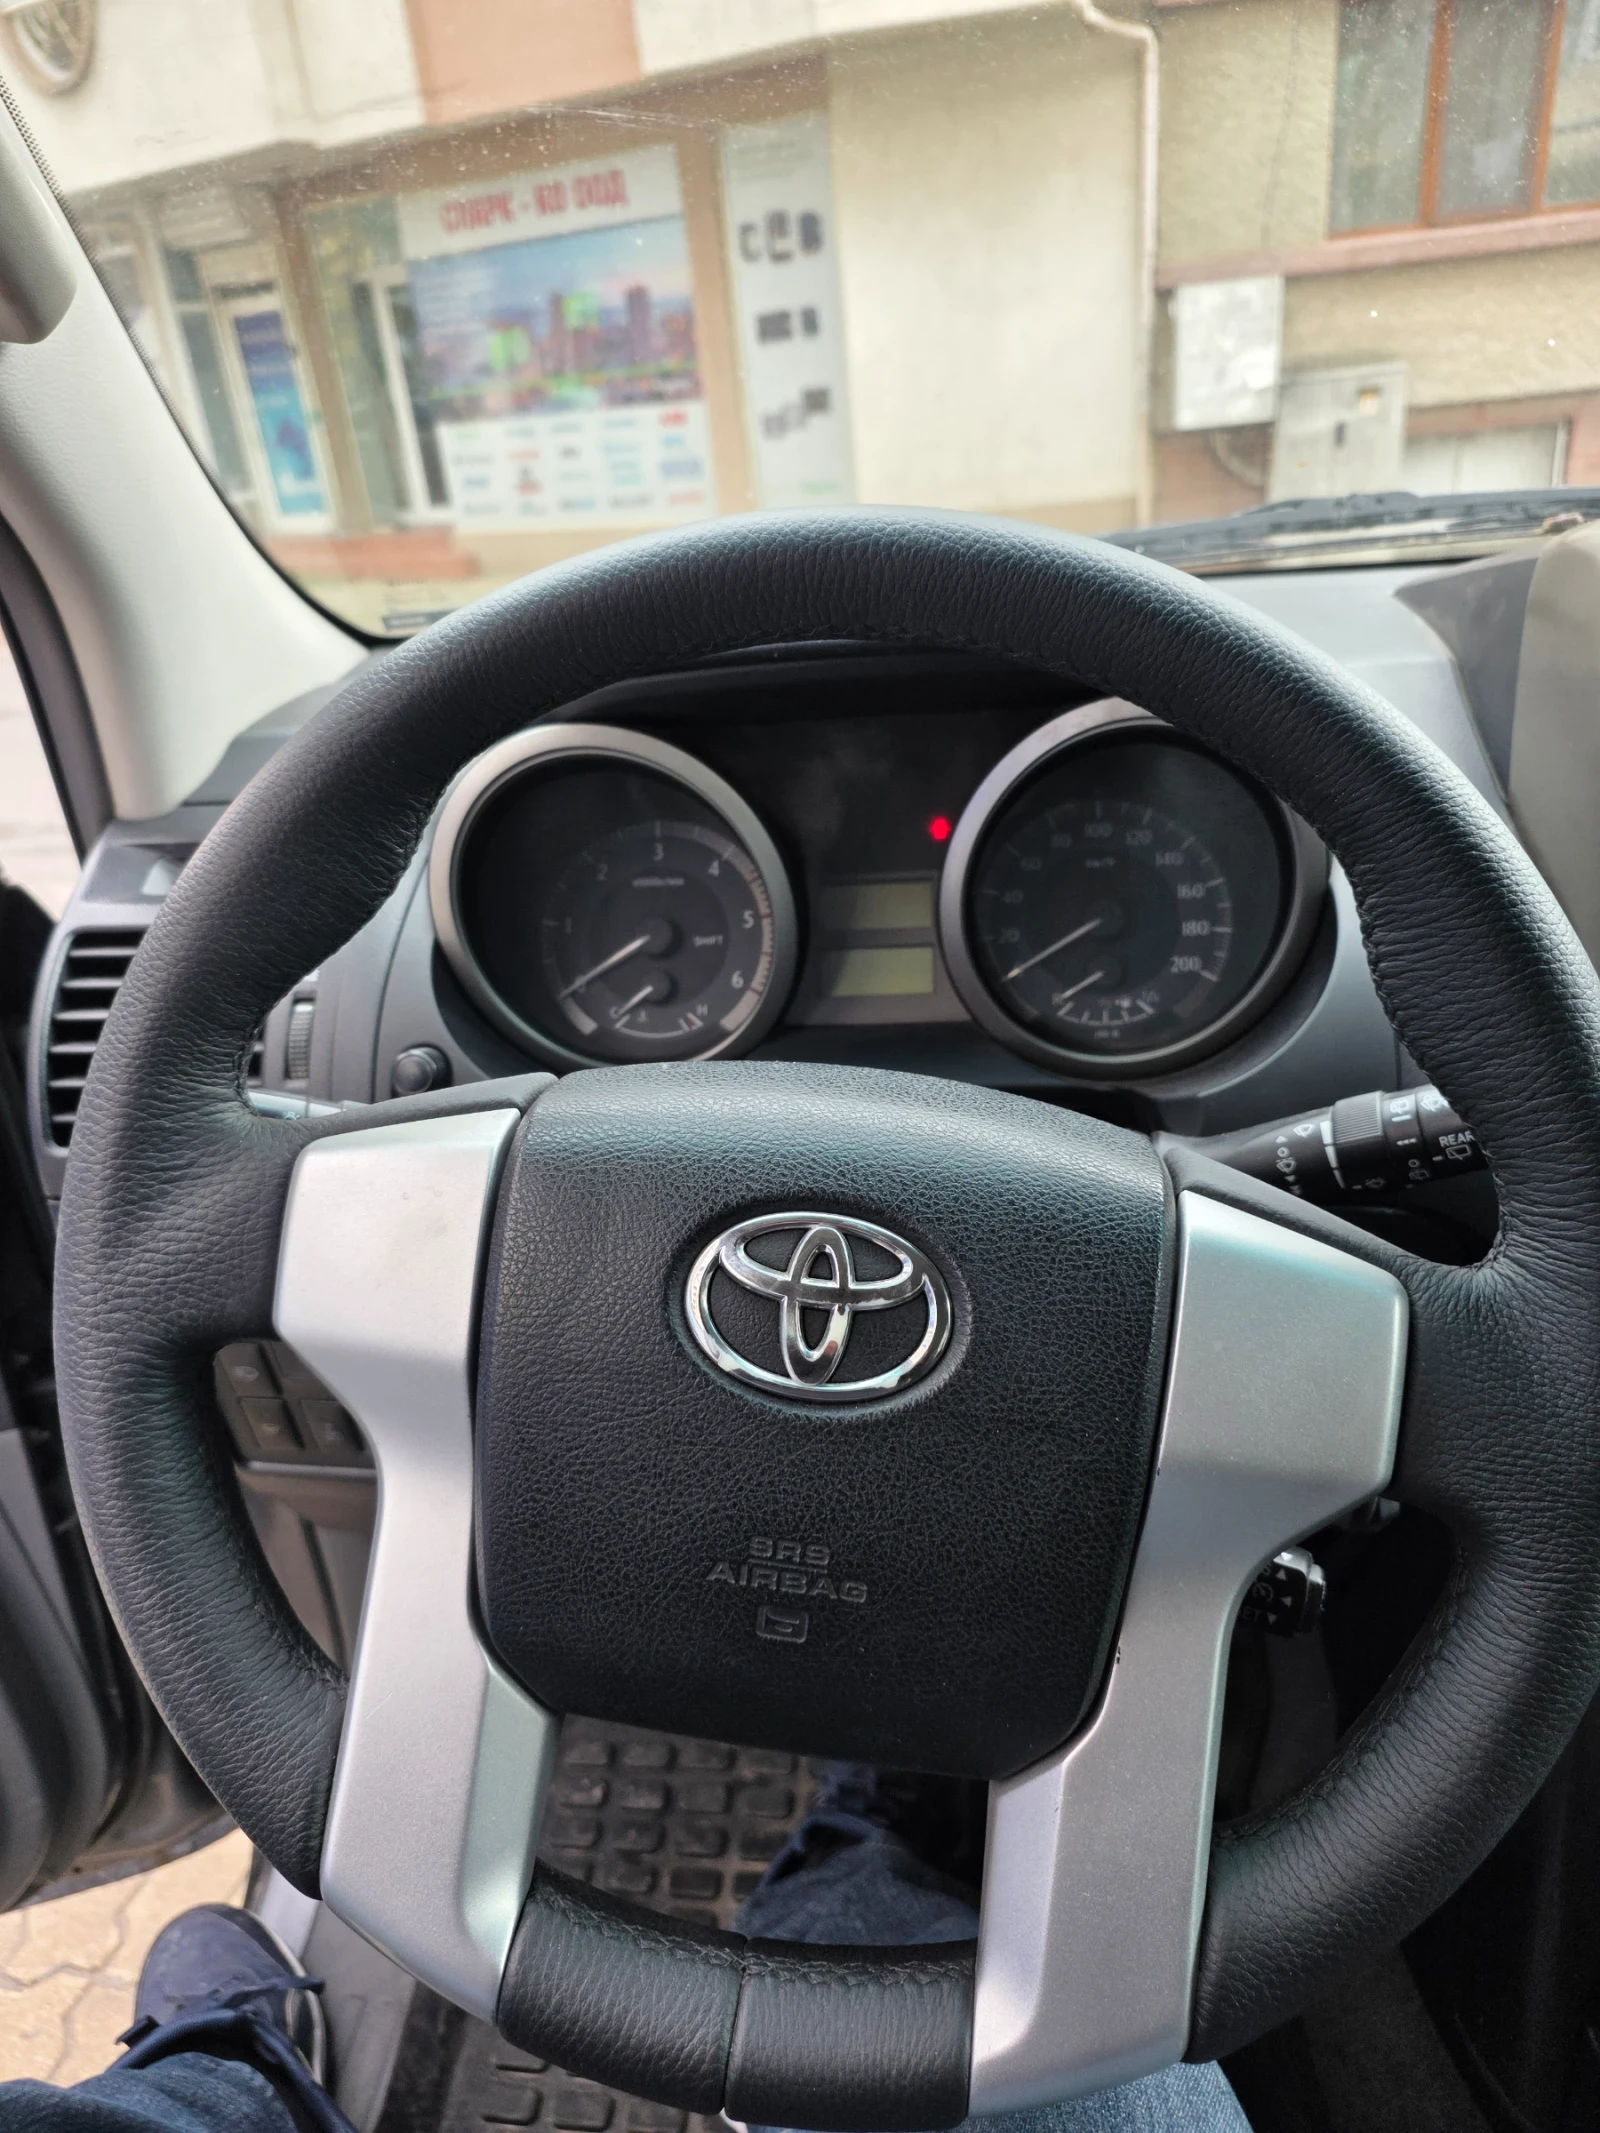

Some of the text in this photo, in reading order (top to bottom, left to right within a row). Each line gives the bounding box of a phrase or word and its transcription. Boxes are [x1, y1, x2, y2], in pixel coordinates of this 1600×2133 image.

[653, 843, 665, 861] 3
[597, 863, 608, 882] 2
[708, 860, 720, 877] 4
[1177, 884, 1206, 900] 160
[743, 911, 755, 929] 5
[1182, 920, 1211, 936] 180
[693, 934, 724, 947] SHIFT
[1170, 956, 1201, 974] 200
[731, 971, 744, 989] 6
[697, 1005, 708, 1017] H
[1438, 1130, 1476, 1148] REAR
[750, 1535, 830, 1566] SRS
[706, 1561, 868, 1603] AIRBAG
